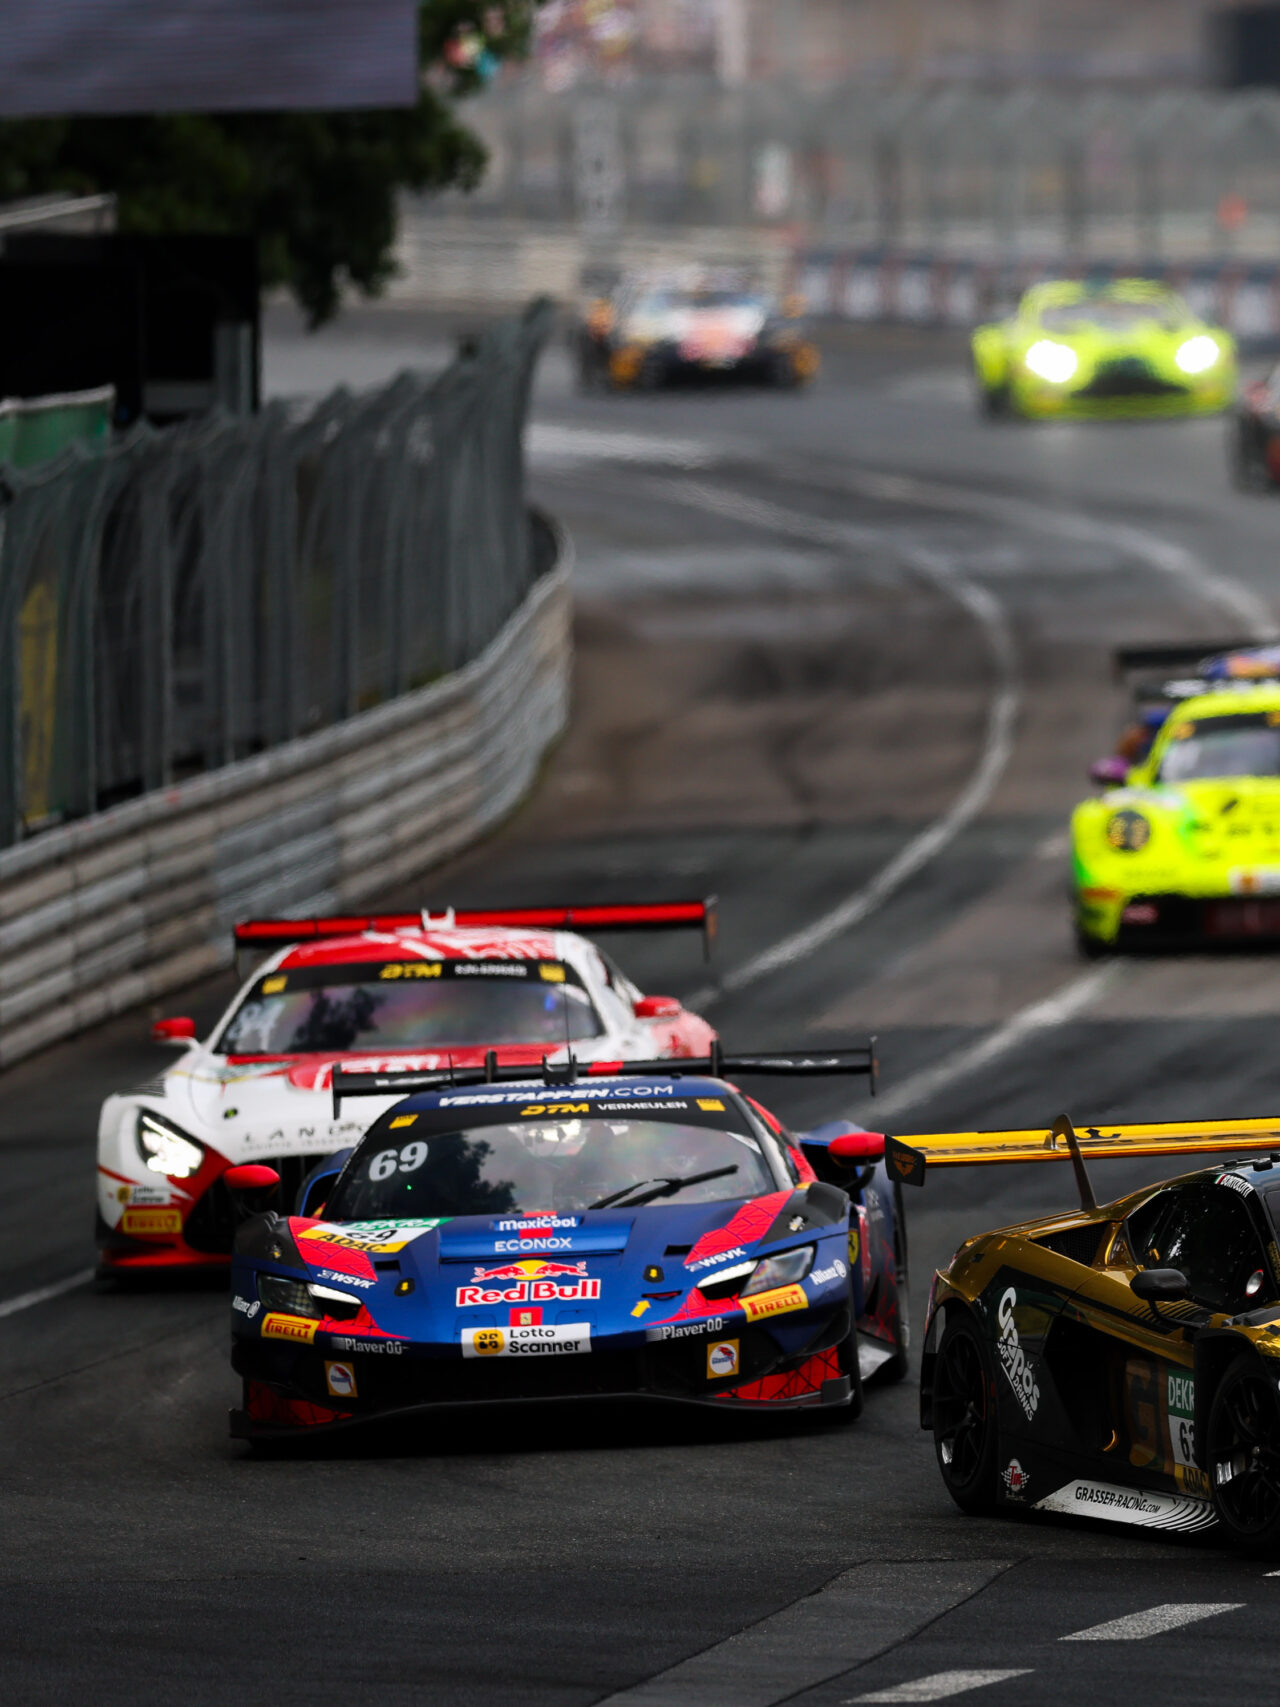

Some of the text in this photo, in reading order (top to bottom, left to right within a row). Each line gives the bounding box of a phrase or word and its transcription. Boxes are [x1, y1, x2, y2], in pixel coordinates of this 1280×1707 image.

[439, 1085, 674, 1107] VERSTAPPEN.COM
[520, 1103, 590, 1116] DTM
[597, 1101, 688, 1111] VERMEULEN
[368, 1141, 429, 1182] 69
[316, 1233, 388, 1252] ADAC
[346, 1229, 398, 1243] 69
[494, 1237, 572, 1252] ECONOX
[809, 1266, 838, 1285] Allianz
[456, 1279, 601, 1307] Red Bull
[748, 1290, 803, 1315] PIRELLI
[265, 1318, 312, 1339] PIRELLI
[509, 1328, 556, 1339] Lotto
[509, 1339, 581, 1354] Scanner
[1168, 1375, 1195, 1411] DEKR
